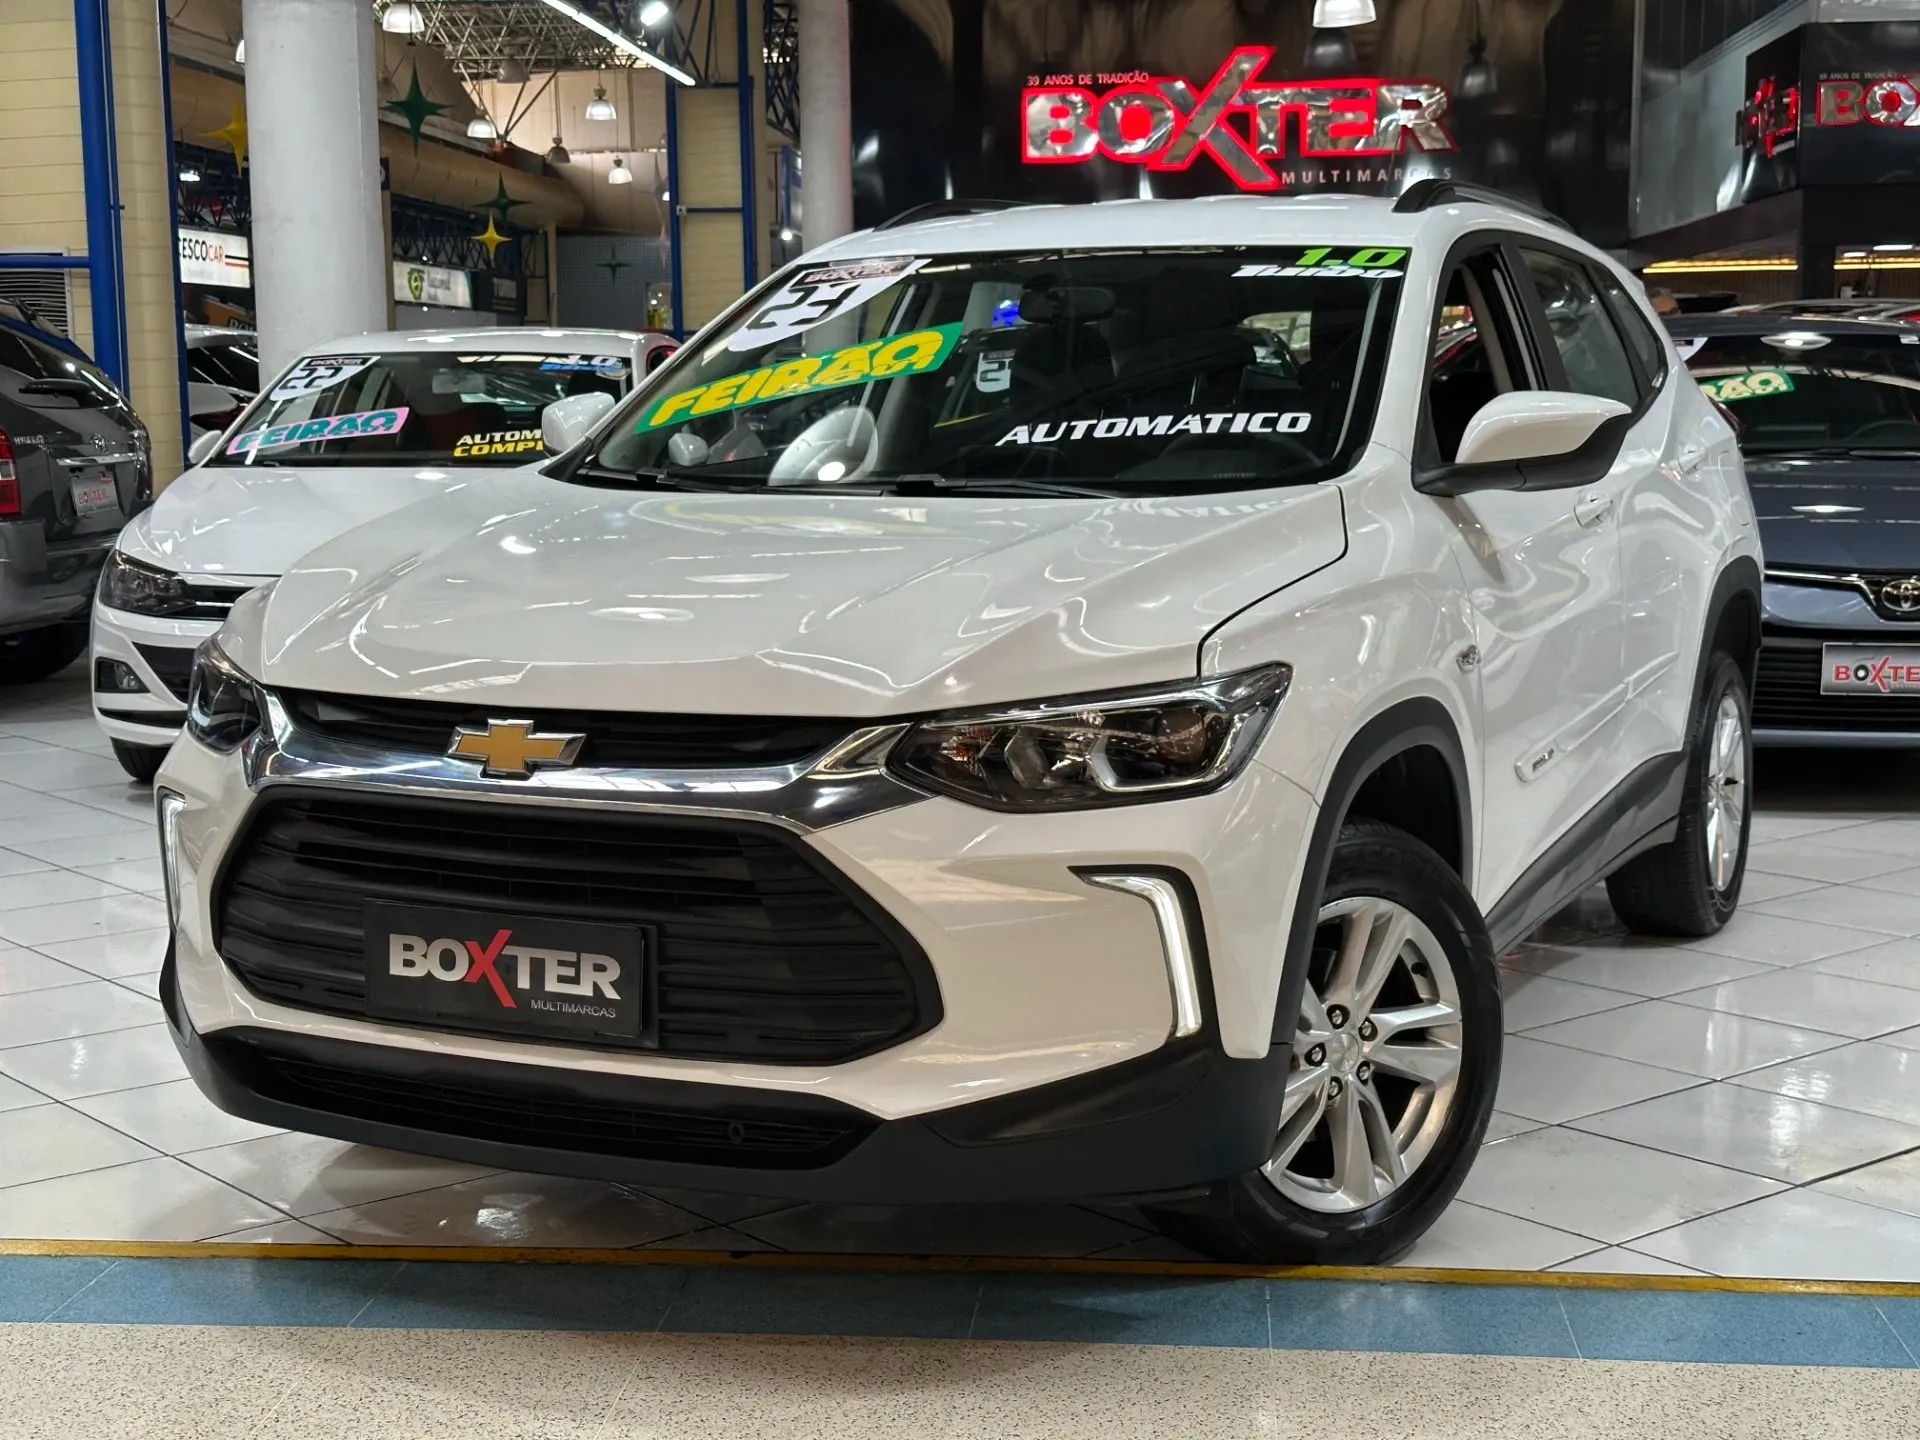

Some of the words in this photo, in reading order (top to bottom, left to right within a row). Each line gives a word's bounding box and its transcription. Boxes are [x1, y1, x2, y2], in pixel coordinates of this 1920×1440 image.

[1026, 75, 1040, 86] 39
[1044, 74, 1074, 85] ANOS
[1078, 74, 1093, 85] DE
[1096, 70, 1149, 84] TRADIÇÃO
[1022, 46, 1459, 190] BOXTER
[1281, 168, 1453, 185] MULTIMARCAS
[1295, 247, 1407, 267] 1.0
[745, 282, 861, 330] 23
[310, 358, 364, 367] BOXTER
[278, 366, 344, 391] 22
[648, 330, 944, 427] FEIRÃO
[235, 411, 399, 452] FEIRÃO
[389, 929, 621, 1008] BOXTER
[530, 998, 617, 1018] MULTIMARCAS
